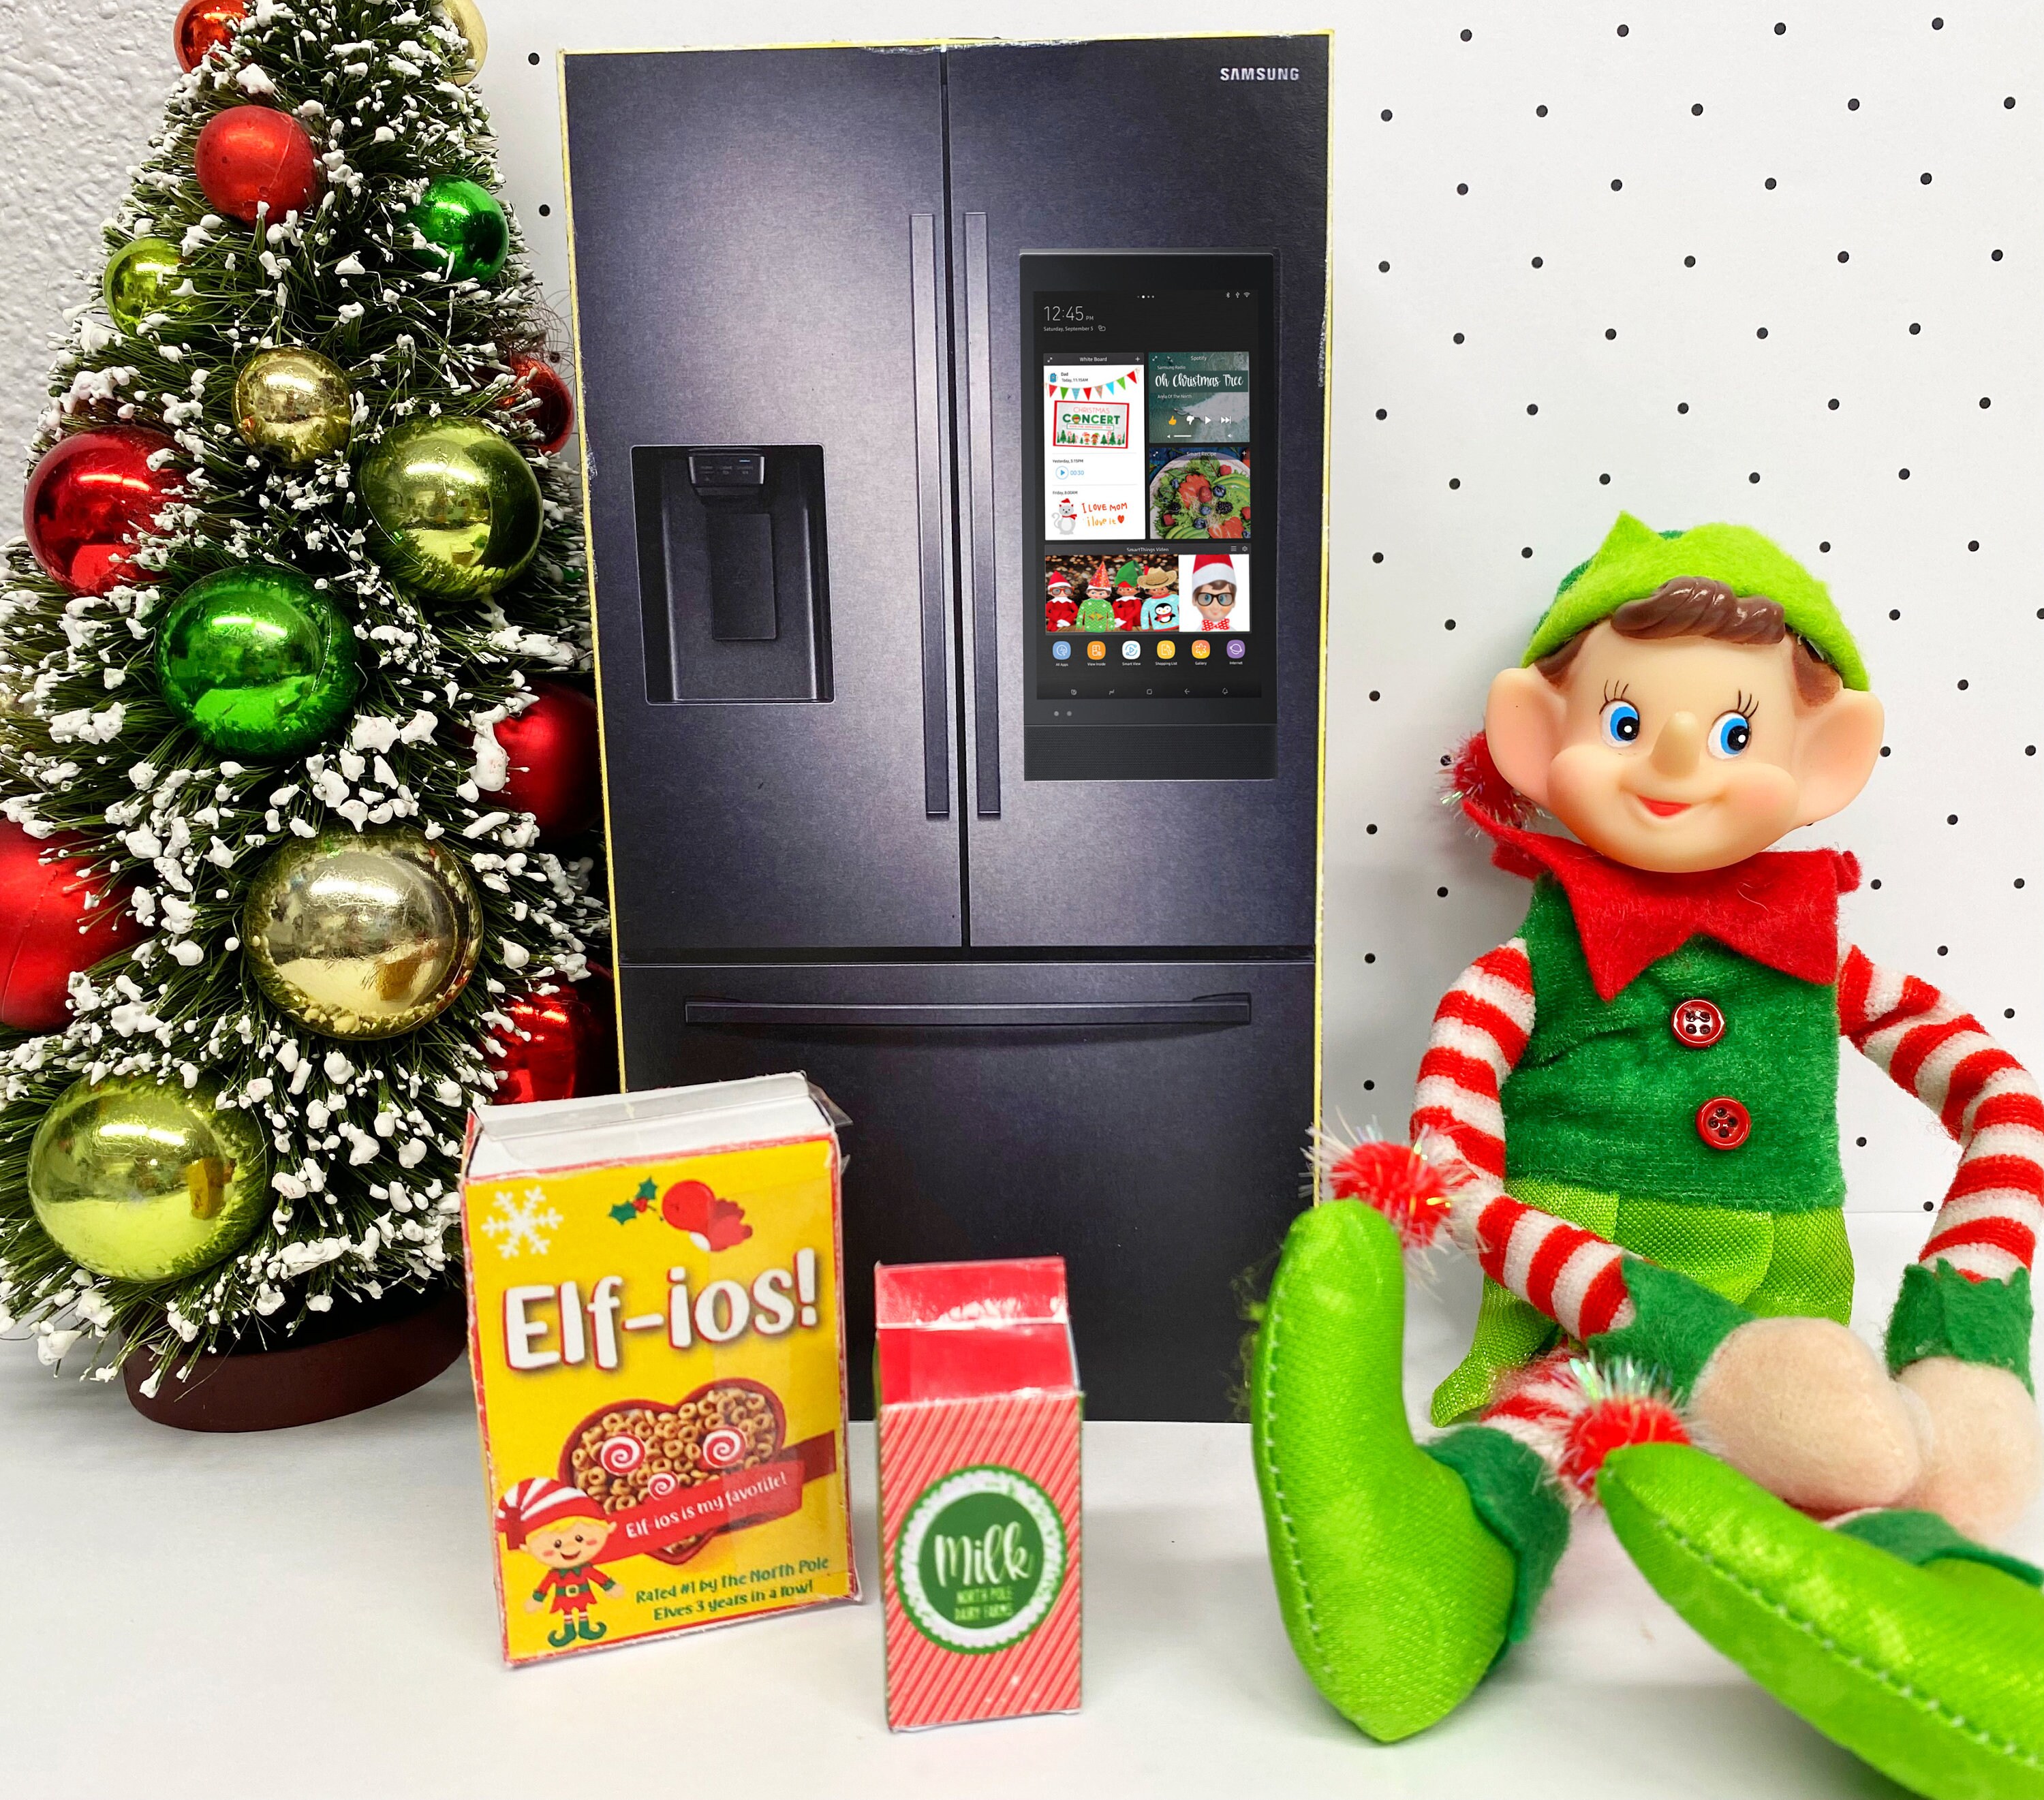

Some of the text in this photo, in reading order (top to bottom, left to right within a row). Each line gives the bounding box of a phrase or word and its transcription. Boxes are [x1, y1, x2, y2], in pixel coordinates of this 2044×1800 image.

[1220, 67, 1300, 81] SAMSUNG
[1044, 306, 1083, 321] 12:45
[1155, 373, 1243, 388] Oh Christmas Tree
[1062, 414, 1120, 424] CONCERT
[1081, 502, 1128, 513] I LOVE MOM
[1087, 516, 1090, 527] i
[1091, 516, 1106, 527] love
[503, 1248, 818, 1370] Elf-ios!
[681, 1505, 695, 1521] is
[697, 1495, 724, 1515] my
[724, 1472, 788, 1508] favorite!
[934, 1521, 1034, 1587] Milk
[636, 1585, 677, 1604] Rated
[681, 1583, 695, 1594] #1
[700, 1578, 717, 1592] by
[750, 1563, 795, 1583] North
[799, 1557, 829, 1574] Pole
[654, 1579, 814, 1621] Elves 3 years in a row!
[957, 1585, 1014, 1604] NORTH POLE
